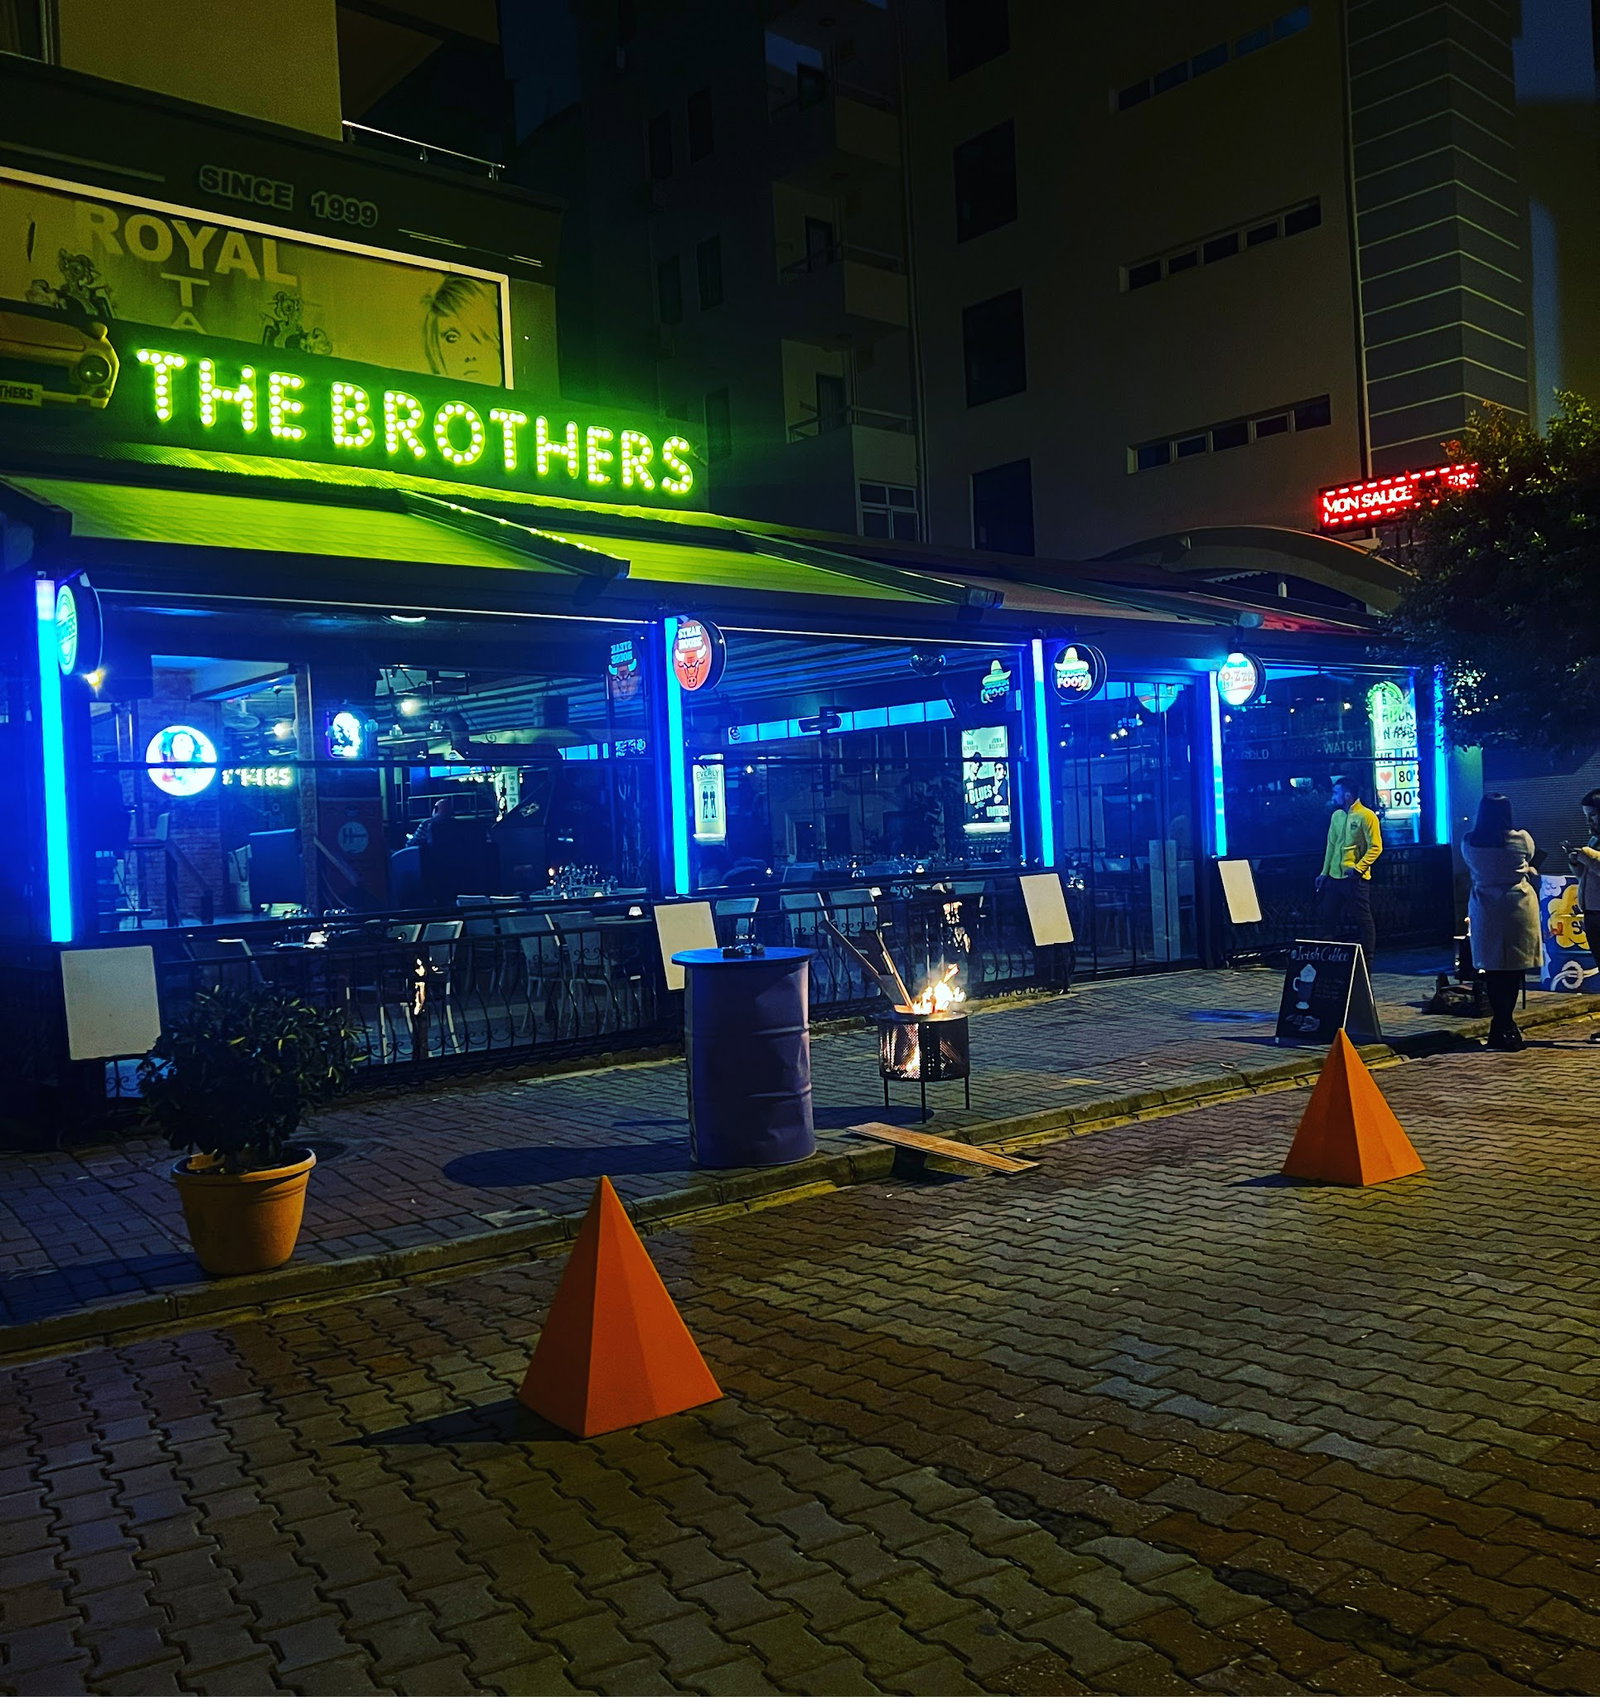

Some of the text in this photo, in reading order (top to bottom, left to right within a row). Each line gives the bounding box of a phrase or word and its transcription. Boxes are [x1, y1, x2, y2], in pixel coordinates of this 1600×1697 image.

[199, 164, 379, 229] SINCE 1999
[75, 201, 298, 288] ROYAL
[136, 348, 693, 494] THE BROTHERS
[1361, 485, 1413, 508] SAUCE
